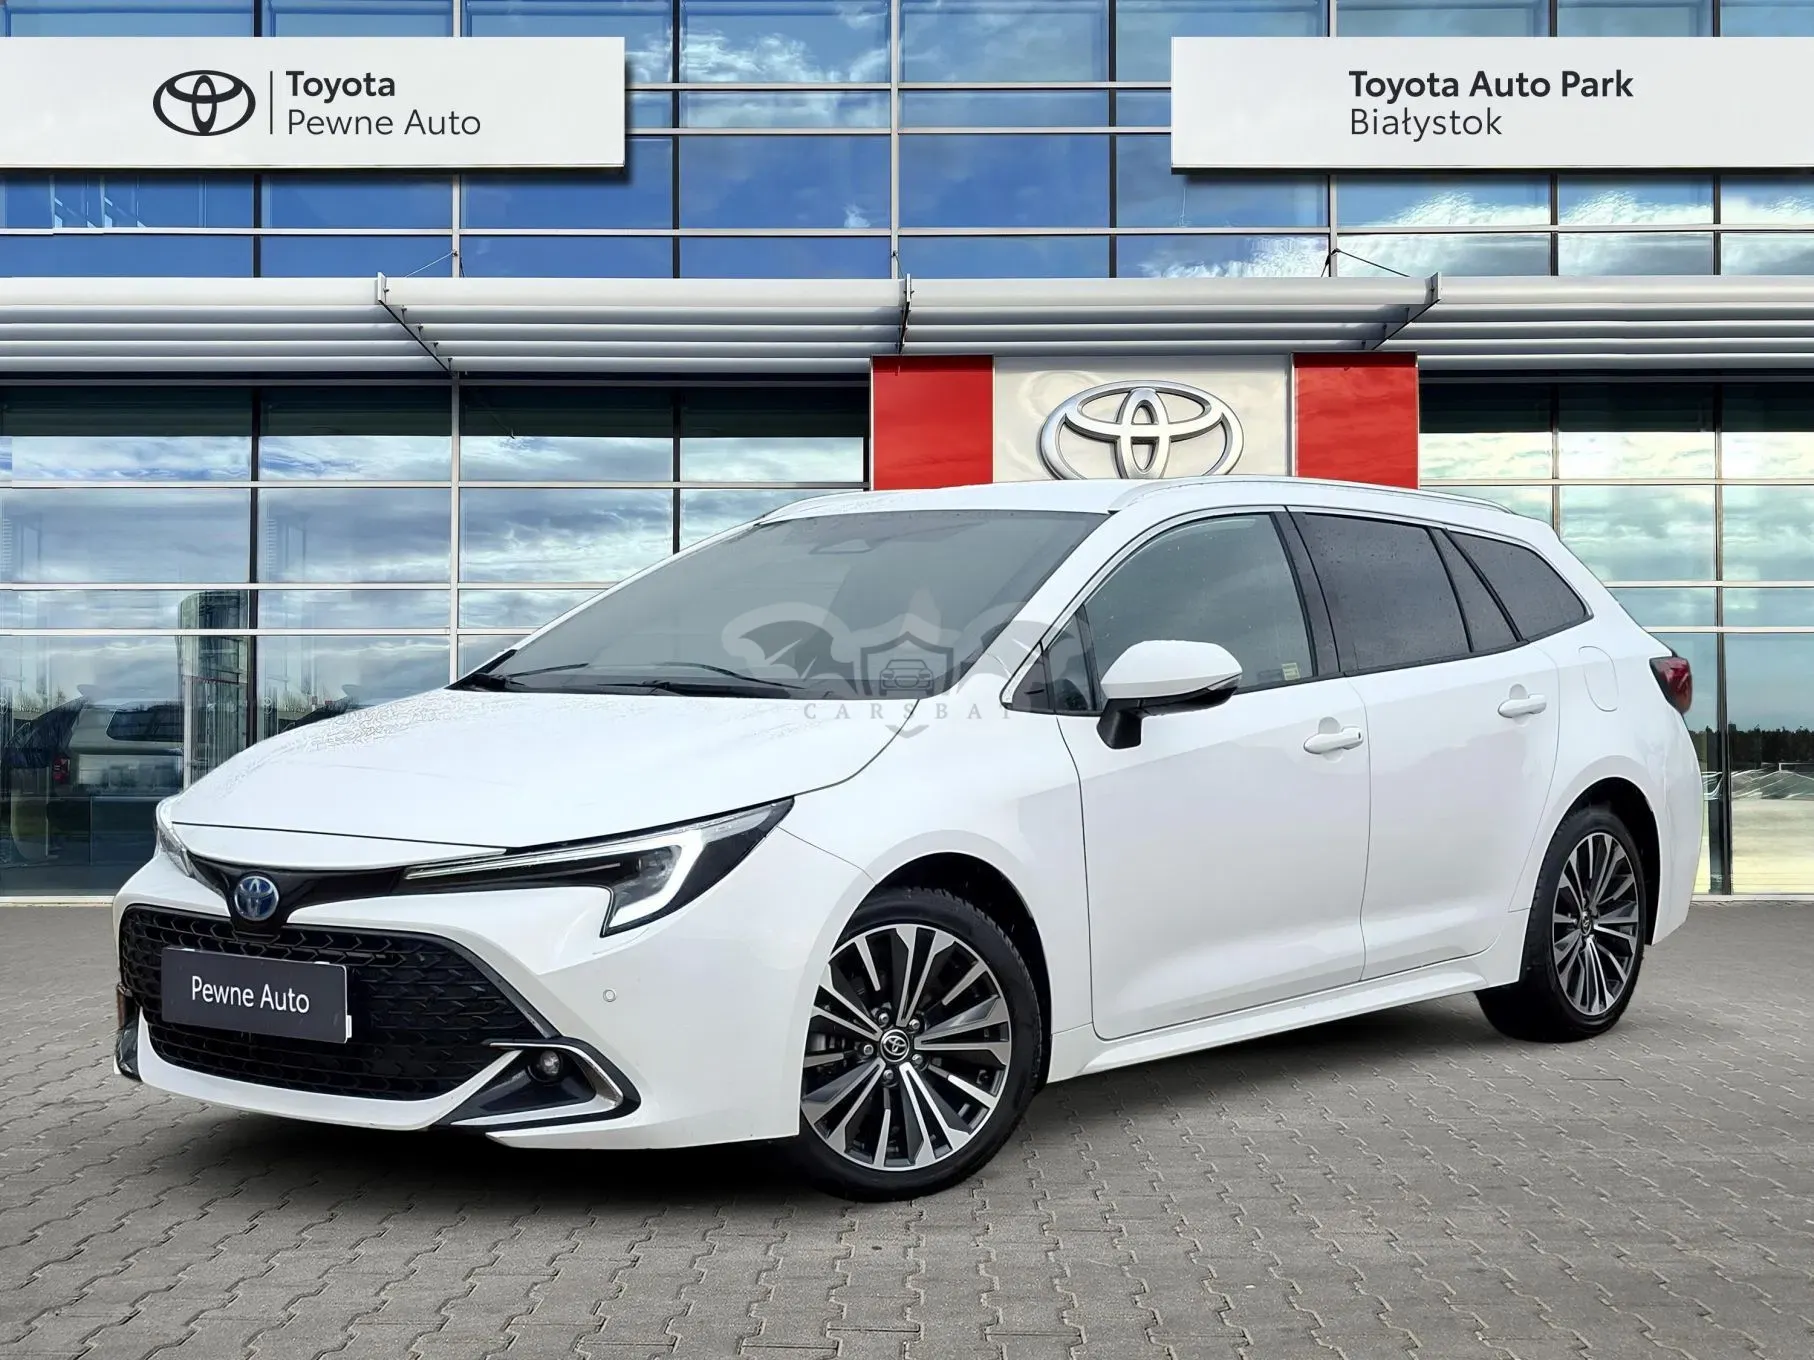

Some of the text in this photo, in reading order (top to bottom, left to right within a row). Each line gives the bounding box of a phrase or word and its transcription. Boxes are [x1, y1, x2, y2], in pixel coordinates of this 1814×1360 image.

[285, 70, 396, 104] Toyota
[1348, 69, 1634, 105] Toyota Auto Park
[288, 108, 481, 136] Pewne Auto
[1351, 106, 1503, 143] Białystok
[191, 975, 311, 1015] Pewne Auto
